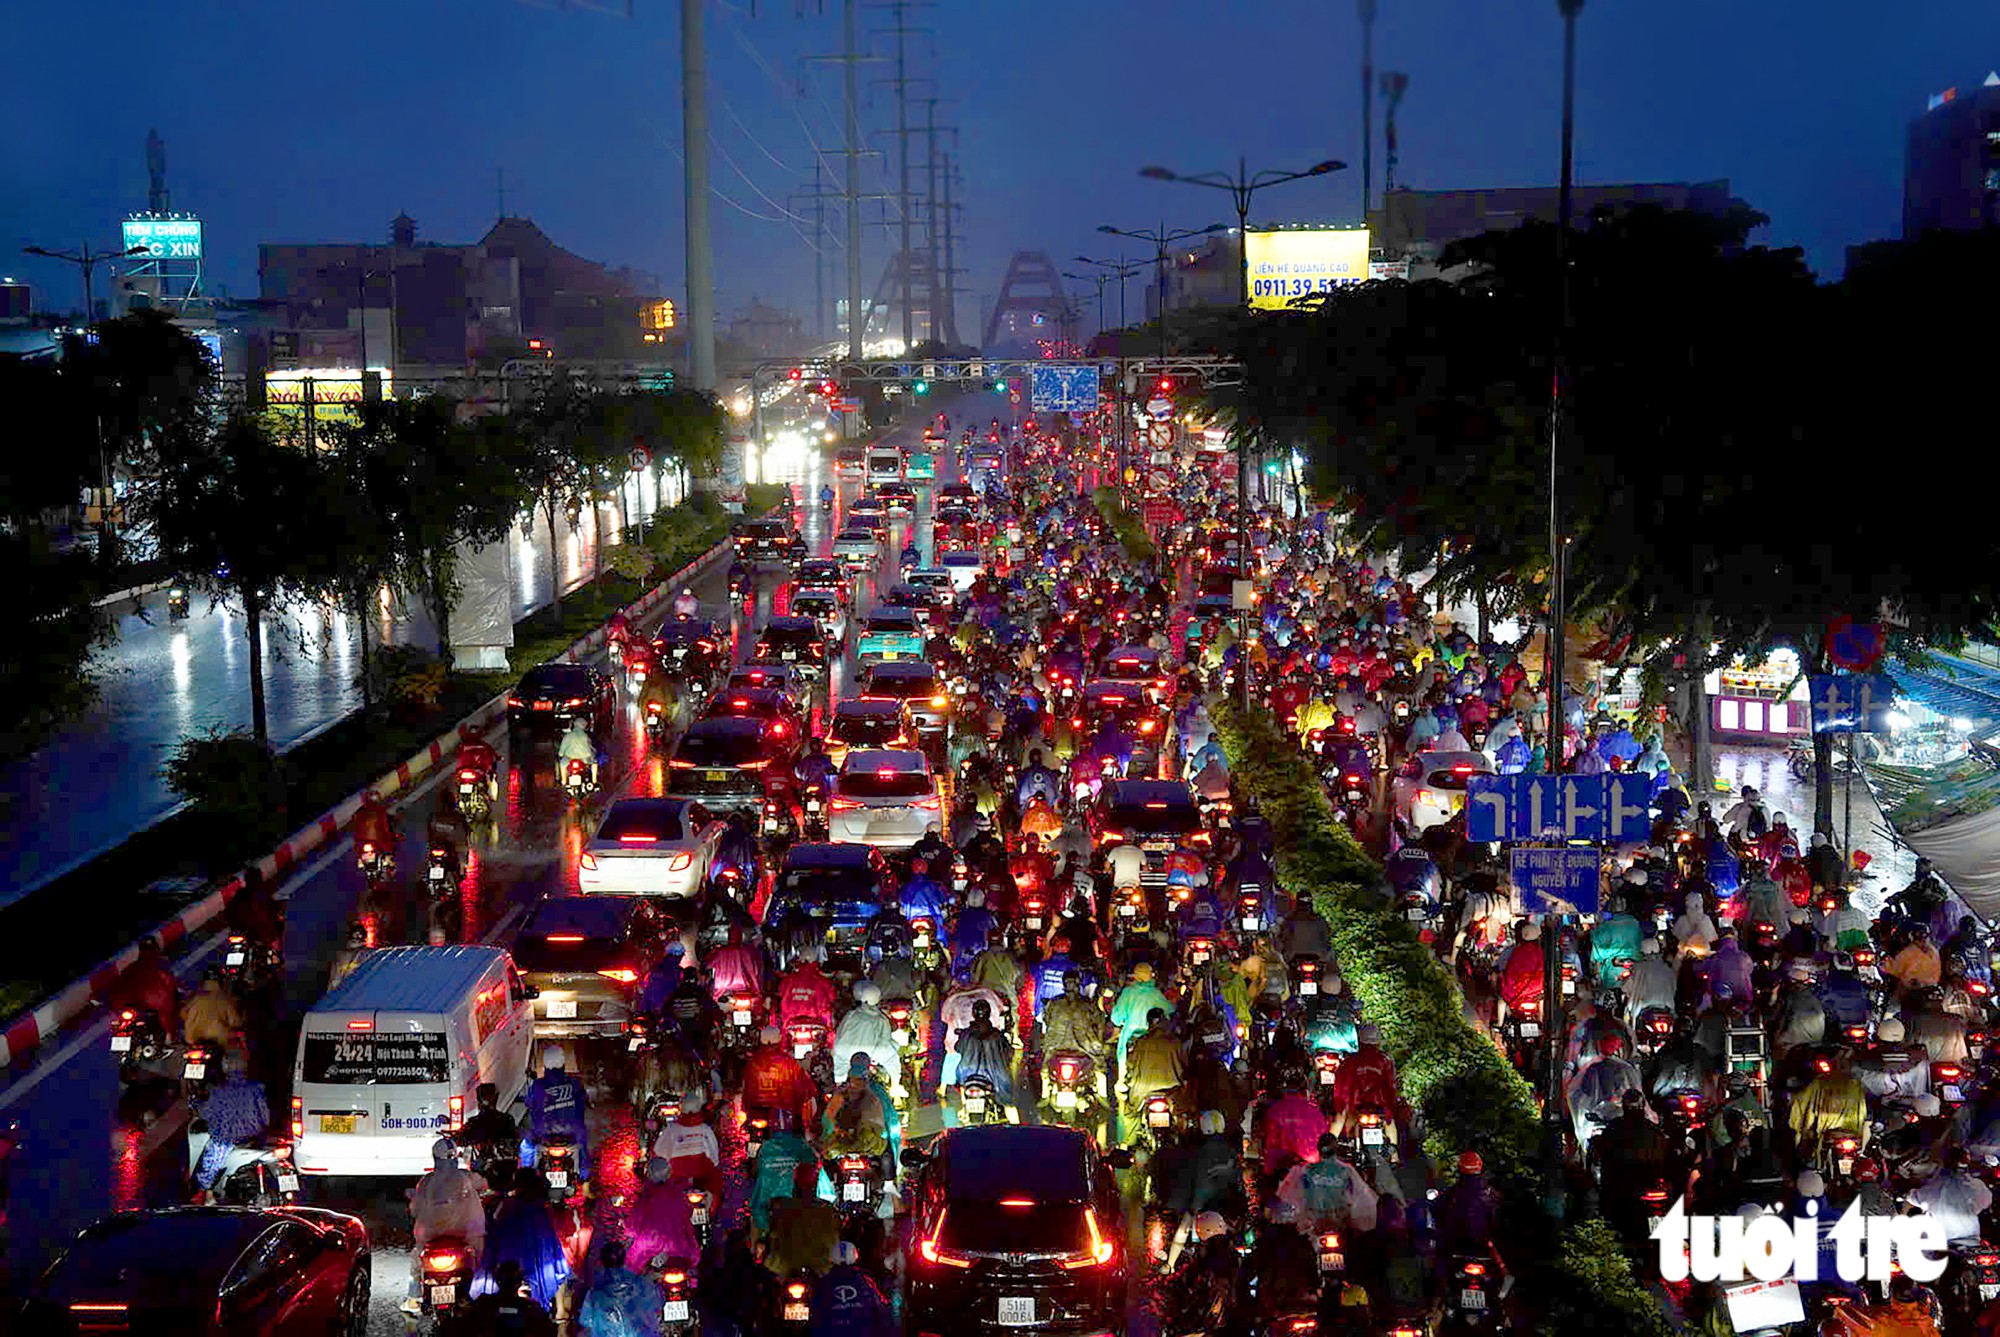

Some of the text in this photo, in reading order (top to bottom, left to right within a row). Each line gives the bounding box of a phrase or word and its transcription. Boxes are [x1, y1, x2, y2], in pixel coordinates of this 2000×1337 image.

[170, 242, 199, 256] XIN
[1254, 262, 1274, 275] LIÊN
[1254, 279, 1312, 297] 0911.39
[339, 1067, 373, 1075] HOTLINE
[1007, 1300, 1026, 1311] 51H
